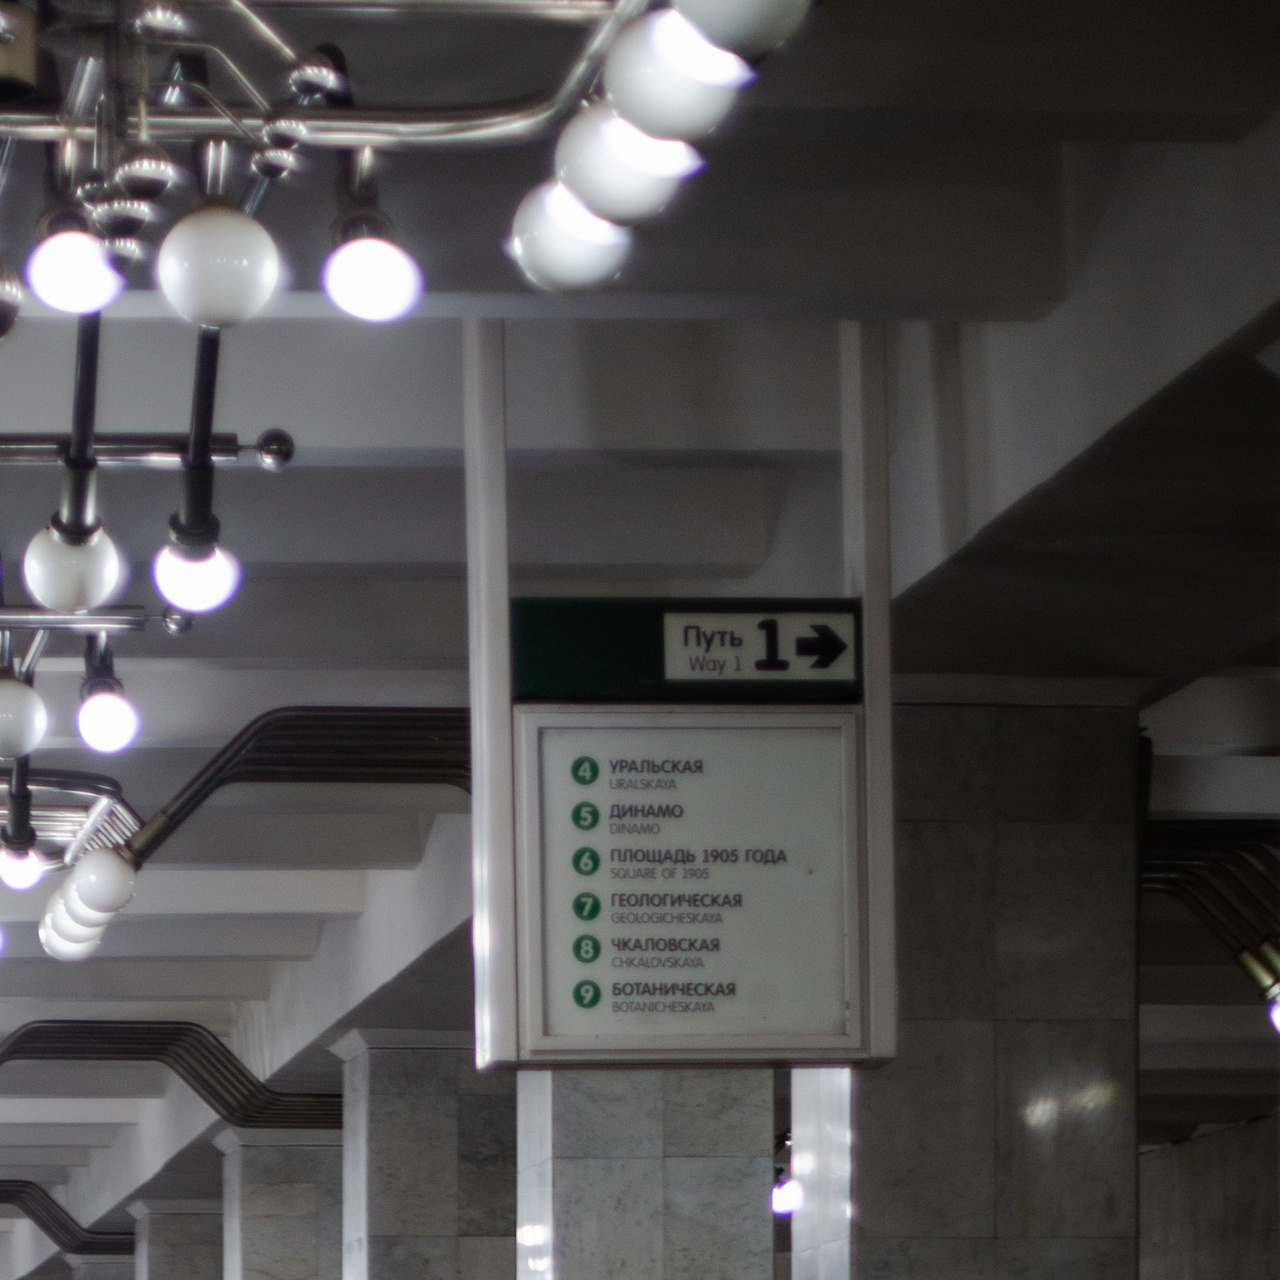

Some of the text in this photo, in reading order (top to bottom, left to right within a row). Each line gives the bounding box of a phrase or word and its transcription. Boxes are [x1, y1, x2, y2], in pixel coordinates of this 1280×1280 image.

[683, 625, 743, 652] Путь
[754, 619, 790, 671] 1
[689, 656, 743, 675] Way 1
[609, 760, 704, 774] УРАЛЬСКАЯ
[609, 778, 677, 790] URALSKAYA
[609, 804, 684, 820] ДИНАМО
[609, 823, 661, 834] DINAMO
[610, 849, 696, 865] ПЛОЩАДЬ
[702, 849, 739, 863] 1905
[745, 849, 787, 865] ГОДА
[610, 868, 709, 880] SQUARE OF 1905
[611, 893, 742, 907] ГЕОЛОГИЧЕСКАЯ
[611, 938, 720, 952] ЧКАЛОВСКАЯ
[612, 982, 736, 996] БОТАНИЧЕСКАЯ
